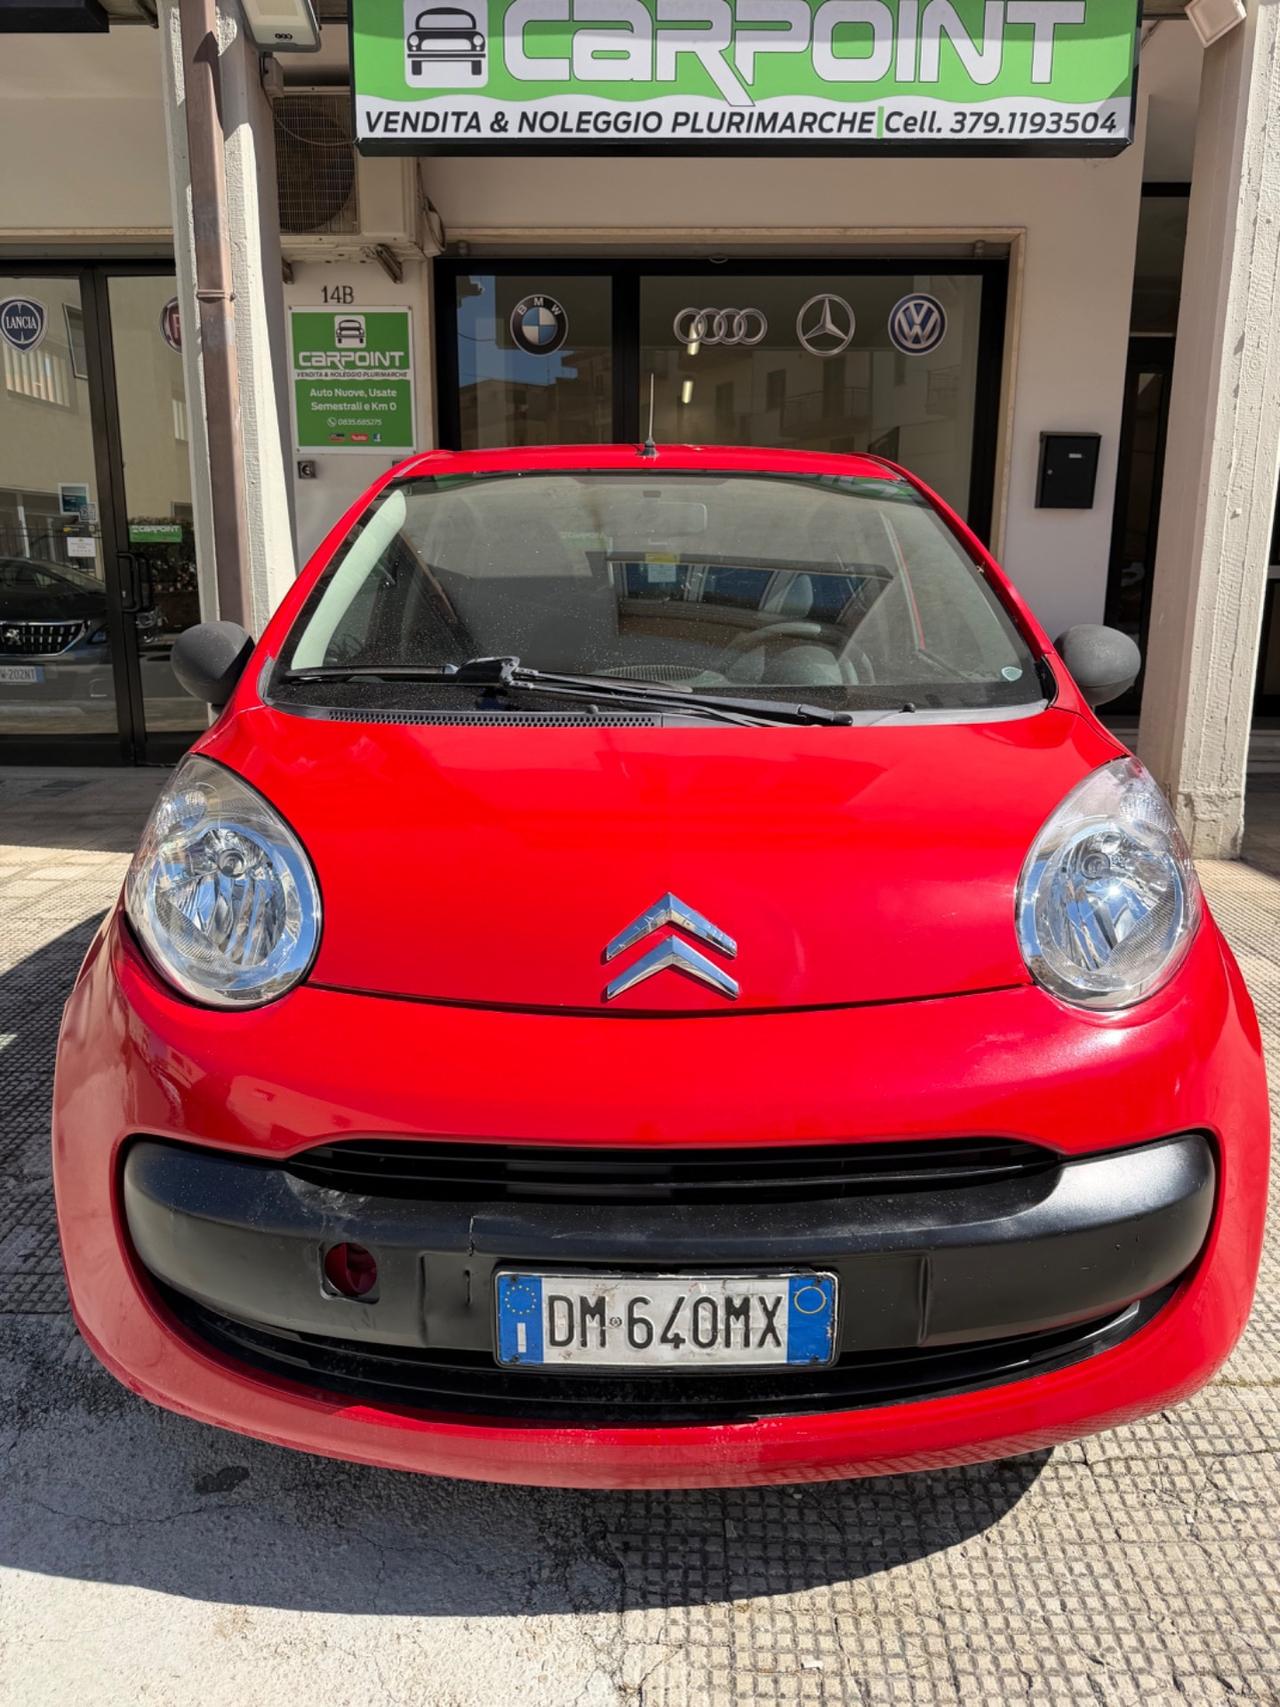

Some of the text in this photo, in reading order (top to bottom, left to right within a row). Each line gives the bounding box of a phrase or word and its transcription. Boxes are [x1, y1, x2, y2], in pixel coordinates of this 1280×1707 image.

[365, 111, 1116, 134] VENDITA & NOLEGGIO PLURIMARCHE Cell. 379.1193504
[321, 285, 355, 304] 14B
[6, 316, 37, 330] LANCIA
[310, 388, 398, 398] Auto Nuove, Usate
[311, 401, 362, 411] Semestrali
[371, 402, 388, 411] Km
